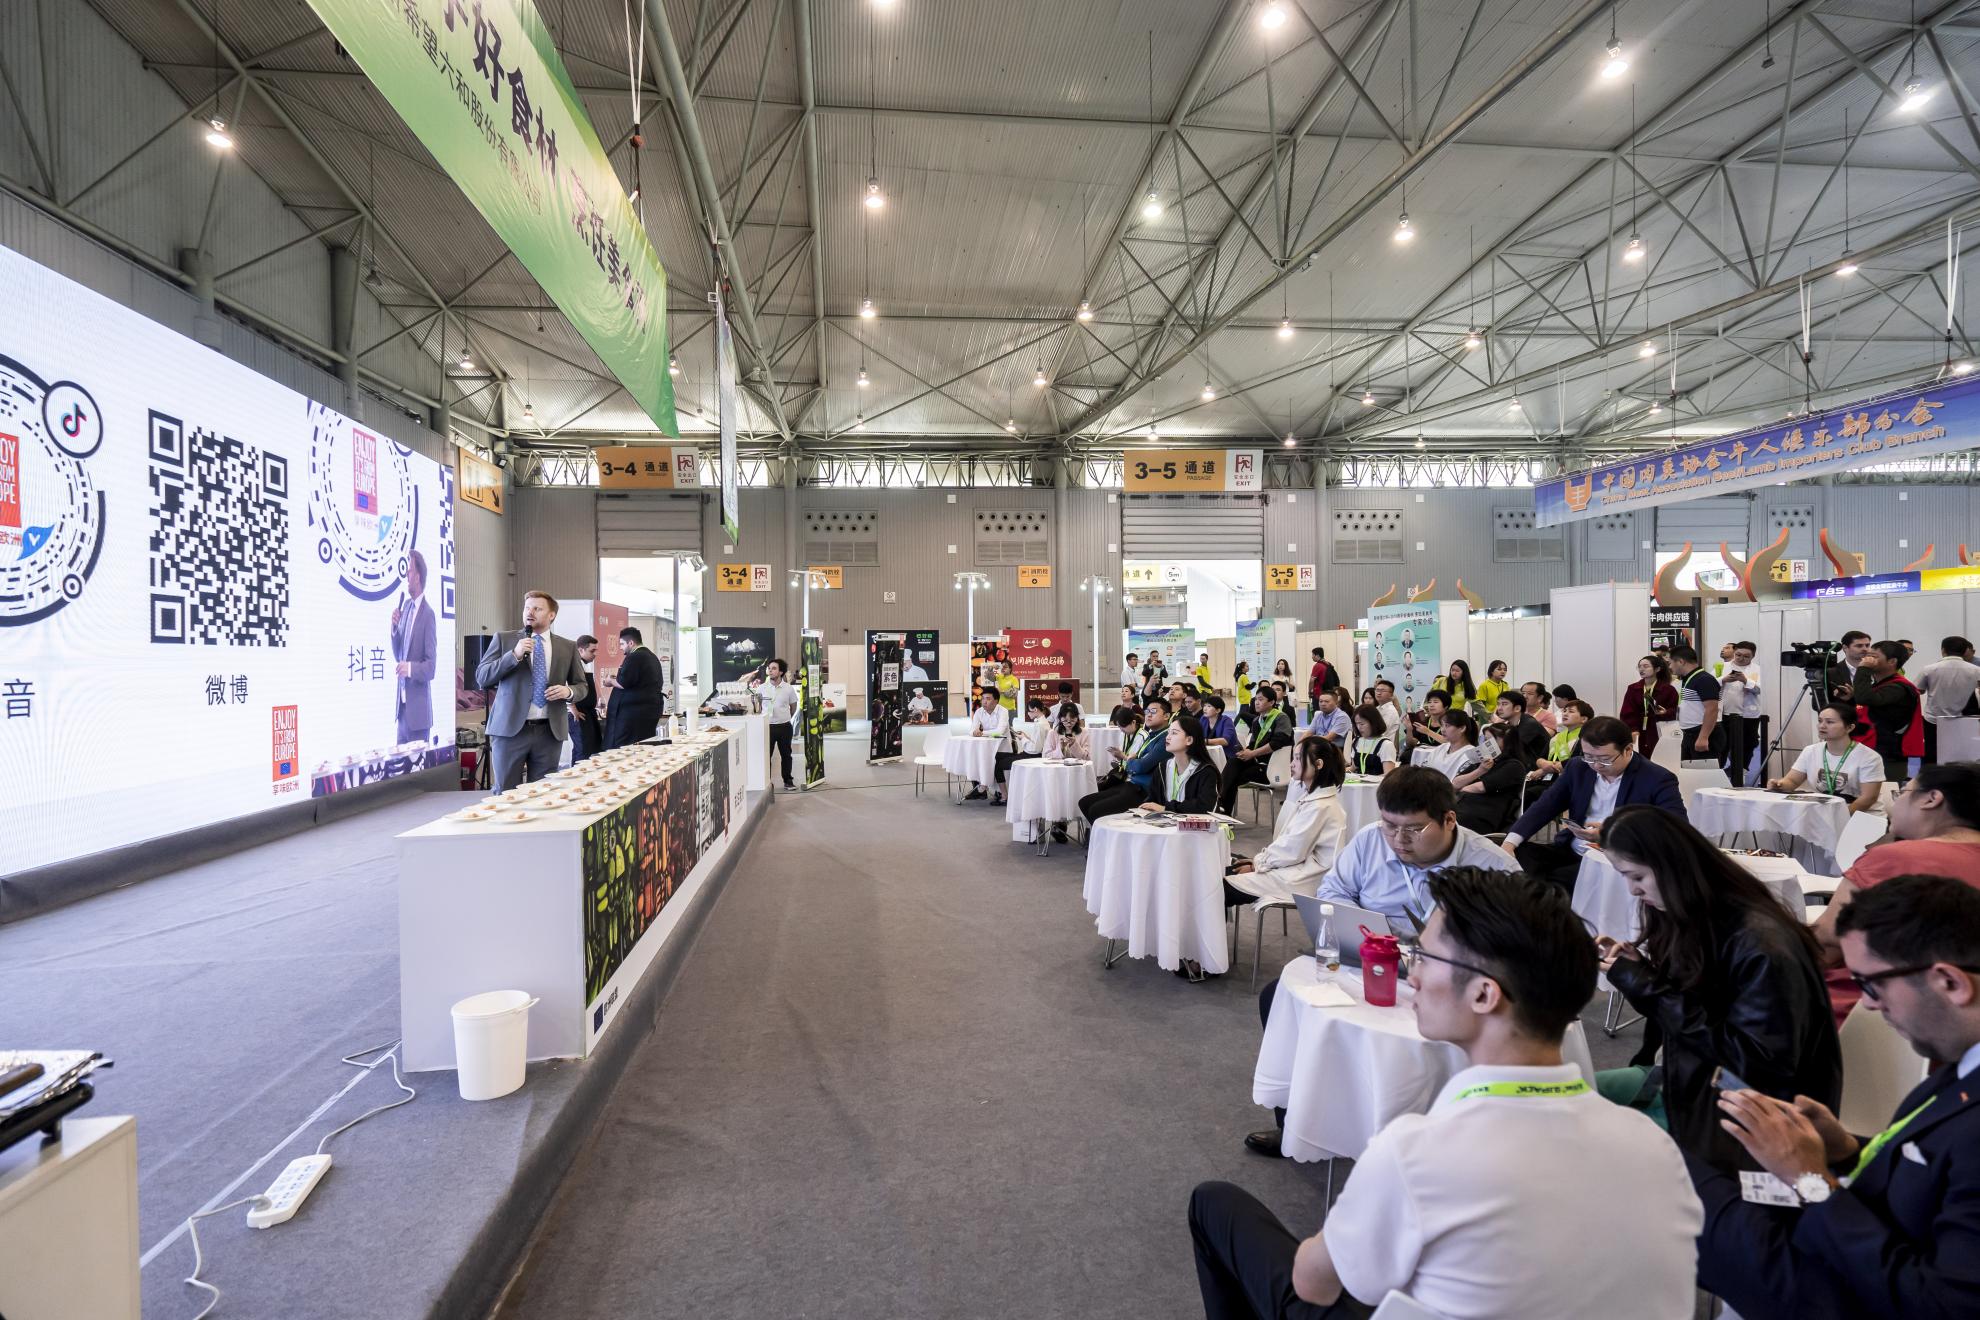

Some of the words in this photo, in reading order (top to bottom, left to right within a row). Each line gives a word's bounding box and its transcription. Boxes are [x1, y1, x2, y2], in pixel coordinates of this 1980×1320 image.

[601, 461, 638, 476] 3-4
[644, 461, 669, 472] 通道
[1652, 474, 1712, 495] Association
[1777, 447, 1844, 470] Importers
[1848, 438, 1883, 456] Club
[1884, 424, 1947, 448] Branch
[1135, 461, 1177, 480] 3-5
[1184, 460, 1216, 475] 通道
[722, 567, 748, 578] 3-4
[1270, 567, 1294, 578] 3-5
[1650, 612, 1691, 623] 牛肉供应链
[347, 645, 387, 682] 抖音
[205, 675, 249, 706] 微博
[273, 708, 297, 731] ENJOY
[274, 742, 297, 762] EUROPE
